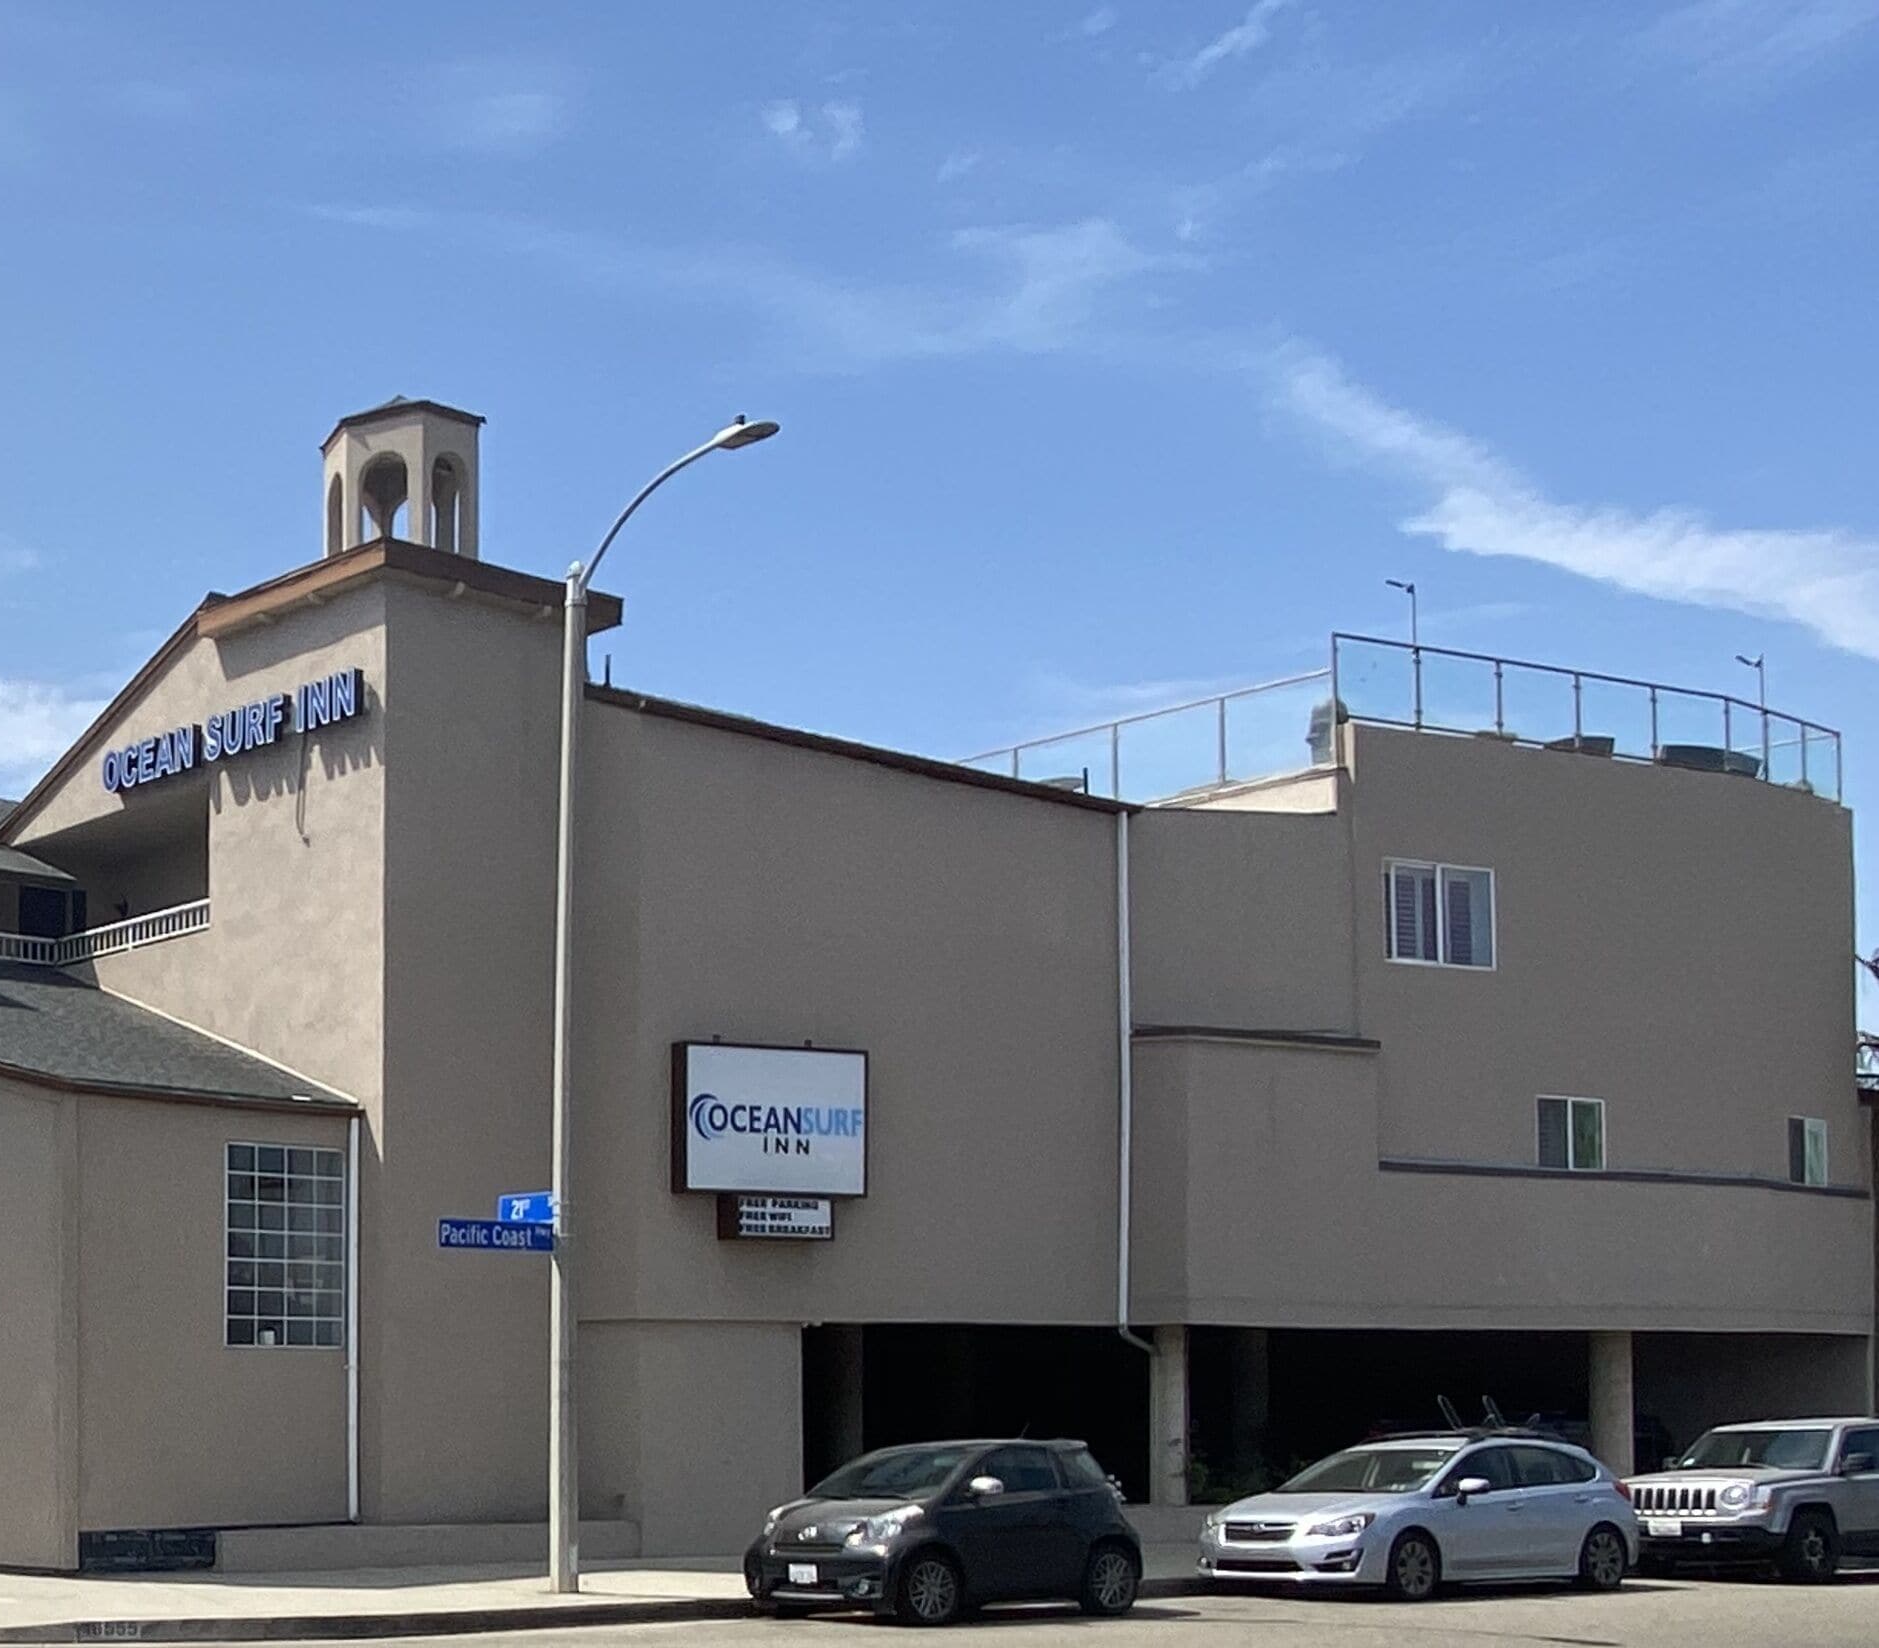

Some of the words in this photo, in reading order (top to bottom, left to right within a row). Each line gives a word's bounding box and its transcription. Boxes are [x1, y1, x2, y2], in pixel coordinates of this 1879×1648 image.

[102, 724, 200, 793] OCEAN
[204, 694, 290, 762] SURF
[295, 668, 362, 733] INN
[762, 1136, 810, 1155] INN
[440, 1223, 489, 1245] Pacific
[492, 1225, 532, 1247] Coast
